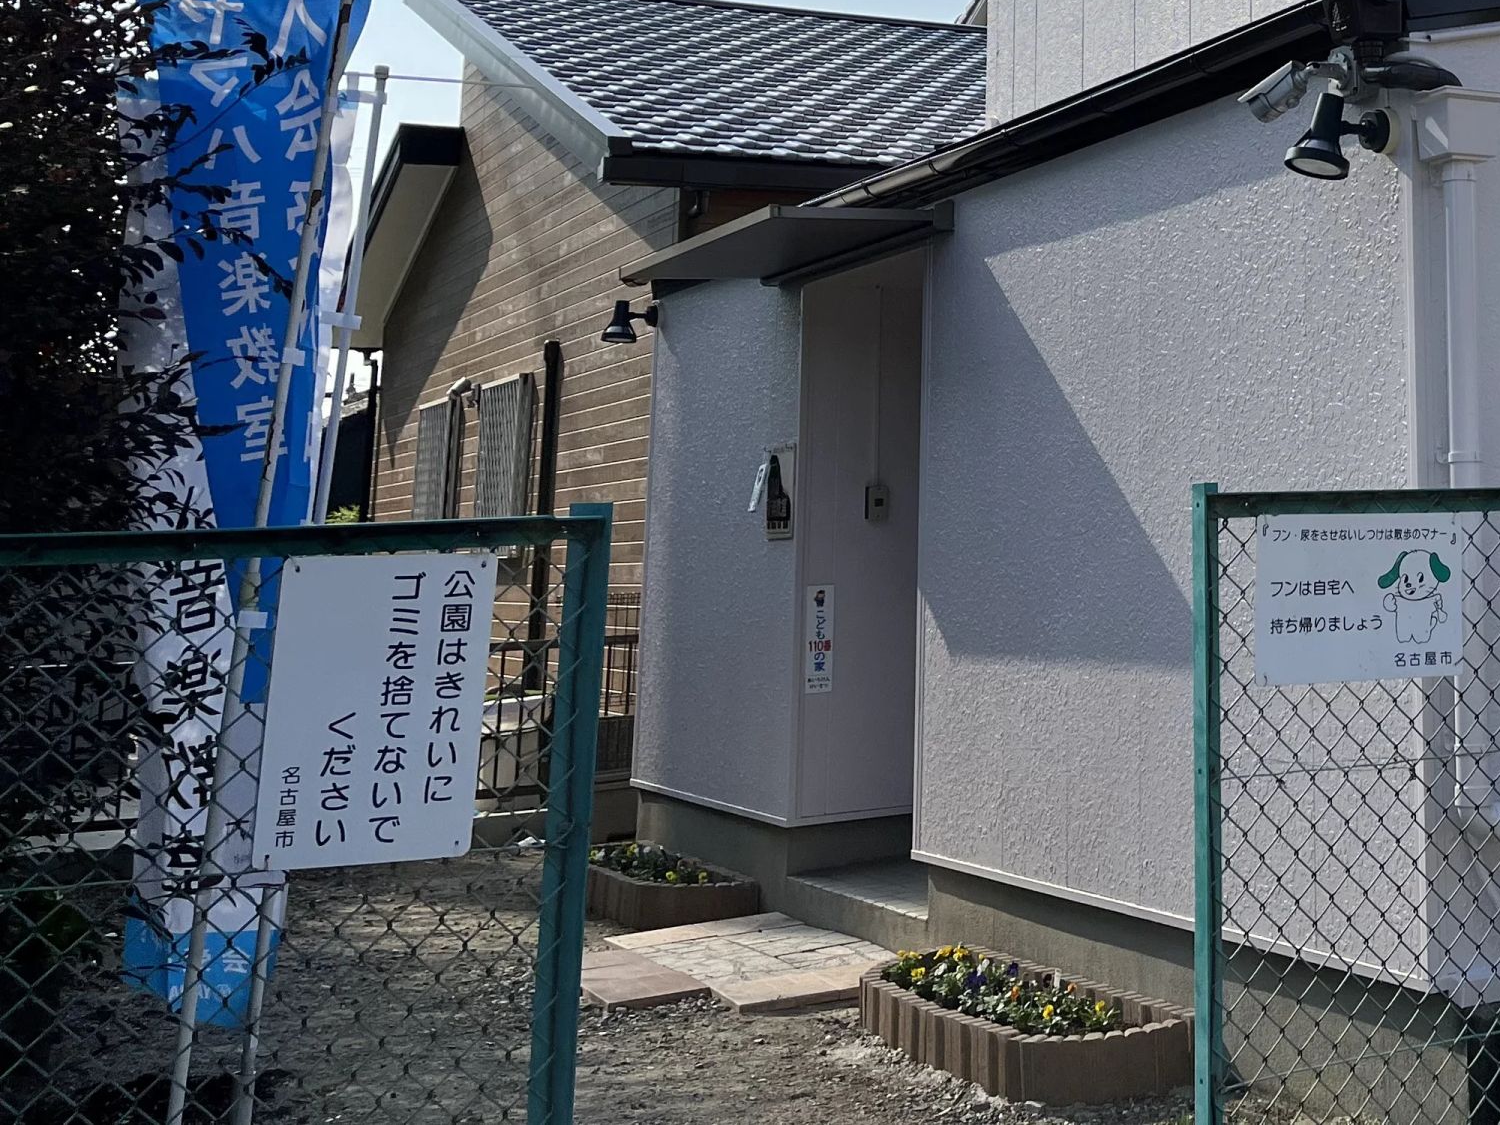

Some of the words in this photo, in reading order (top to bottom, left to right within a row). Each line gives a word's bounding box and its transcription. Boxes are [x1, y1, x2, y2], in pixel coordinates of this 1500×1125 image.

[1270, 579, 1355, 597] フンは自宅へ
[1270, 614, 1383, 635] 持ち帰りましょう
[424, 570, 476, 804] 公園はきれいに
[1394, 650, 1453, 668] 名古屋市
[368, 571, 427, 844] ゴミを捨てないで
[275, 766, 301, 849] 名古屋市
[315, 712, 357, 847] ください
